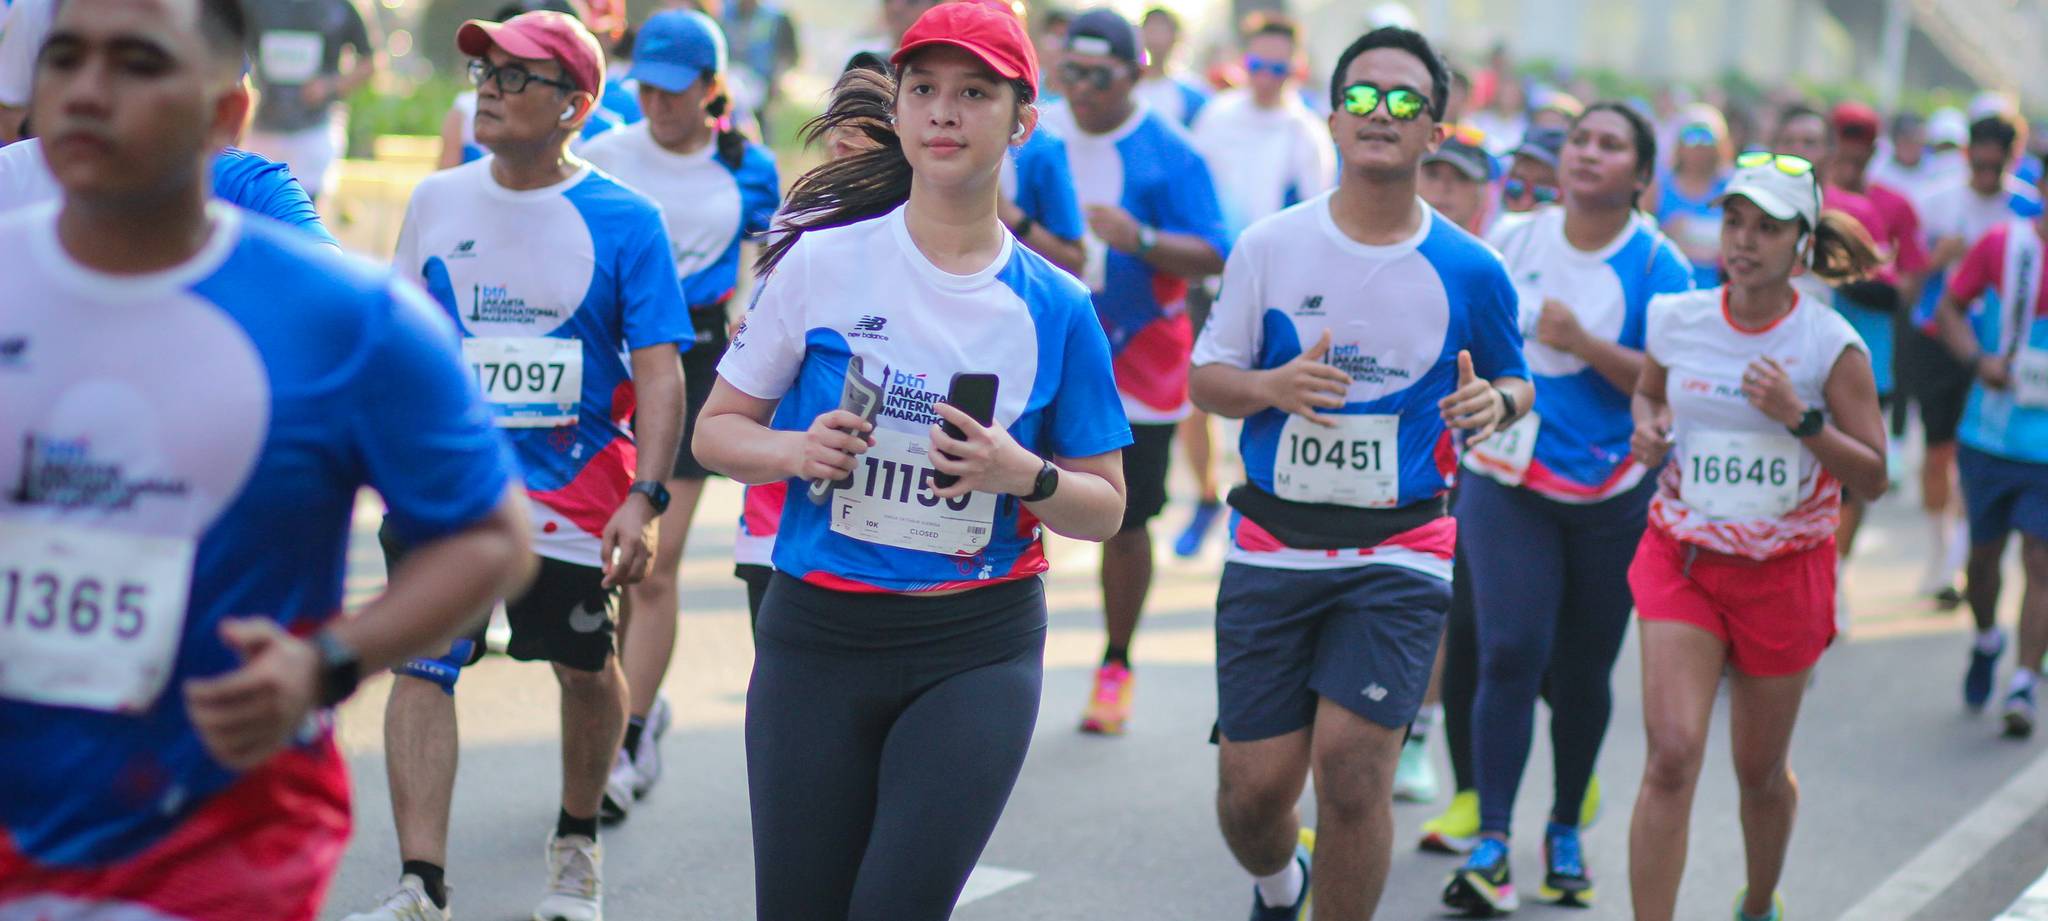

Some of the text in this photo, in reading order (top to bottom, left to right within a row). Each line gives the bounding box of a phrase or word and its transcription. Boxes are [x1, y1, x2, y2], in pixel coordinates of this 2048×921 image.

[481, 306, 559, 318] INTERNATIONAL
[482, 298, 525, 307] JAKARTA
[480, 315, 536, 325] MARATHON
[861, 332, 889, 341] balance
[894, 369, 927, 389] btn
[886, 395, 939, 415] INTERN
[888, 385, 948, 405] JAKARTA
[884, 407, 945, 428] MARATHO
[1291, 434, 1381, 472] 10451
[1692, 455, 1788, 486] 16646
[842, 504, 853, 519] F
[865, 519, 880, 529] 10K
[910, 528, 939, 540] CLOSED
